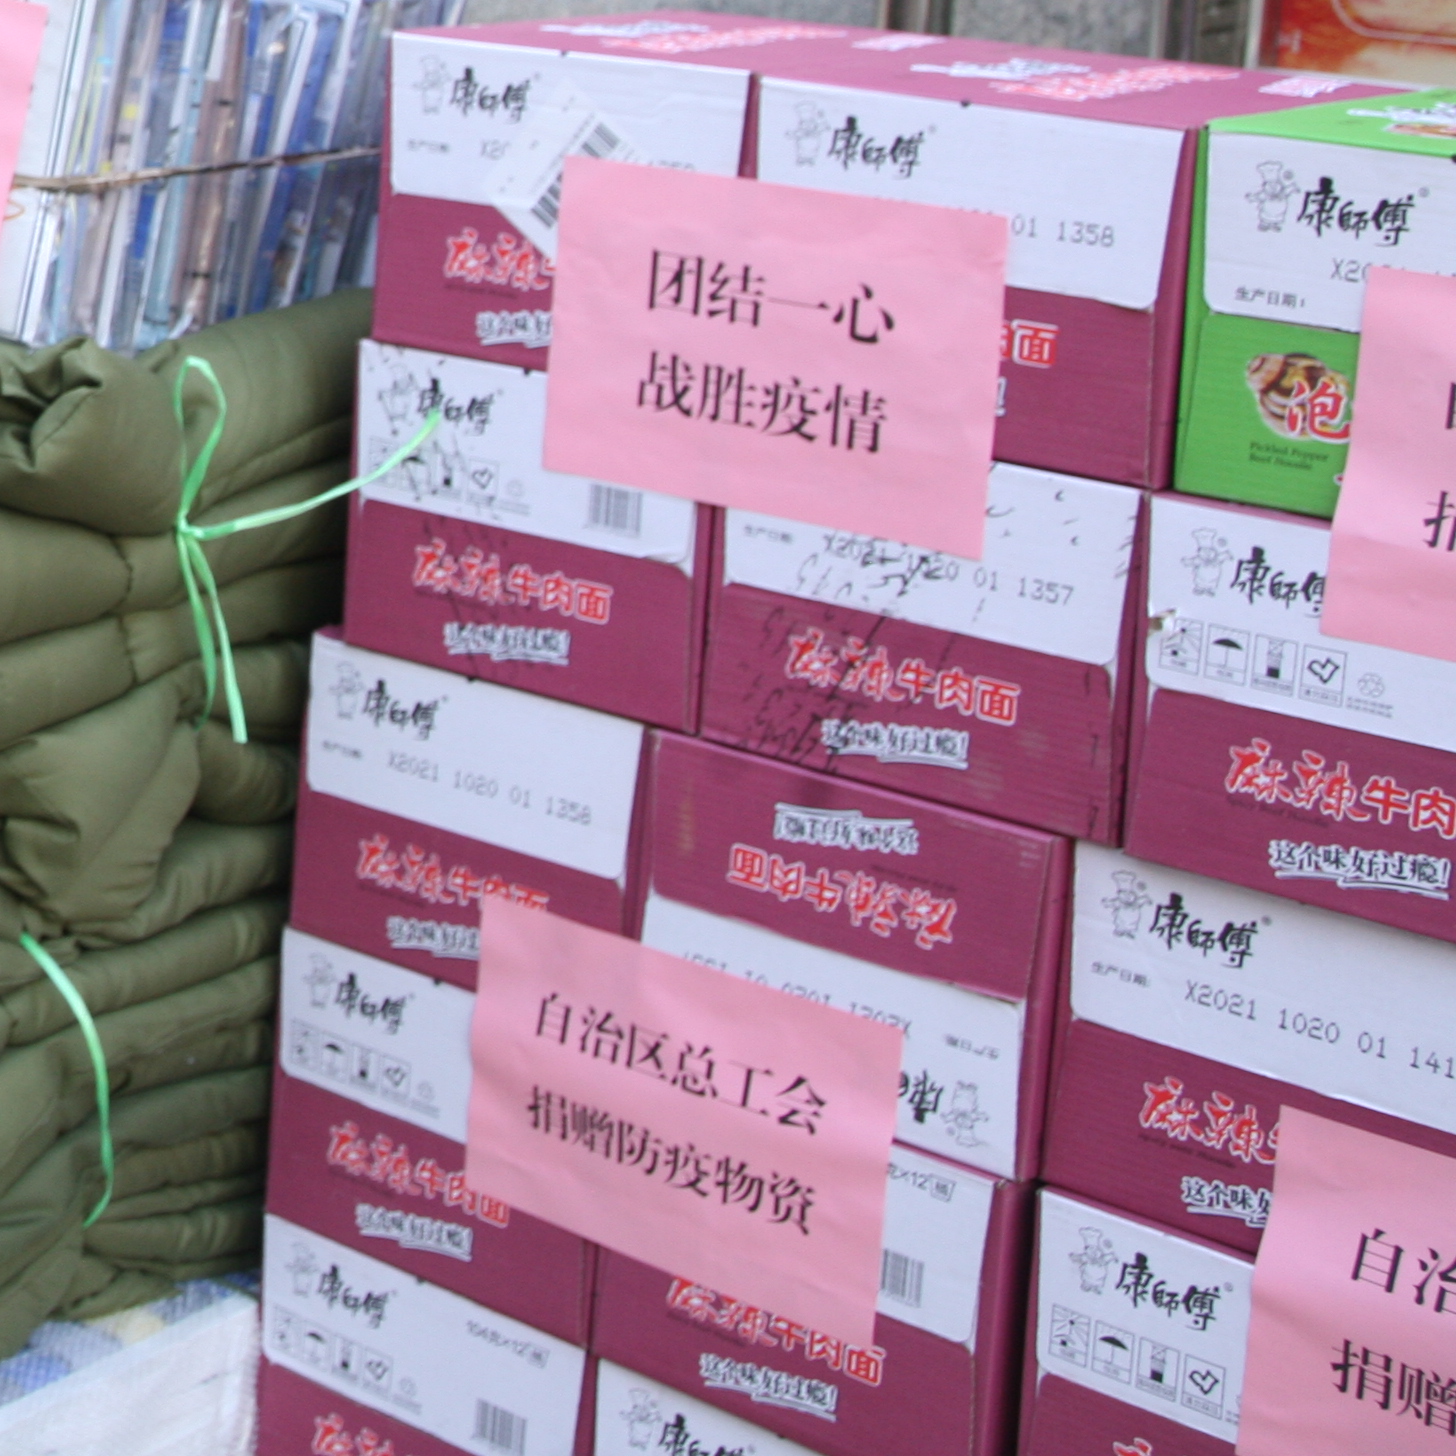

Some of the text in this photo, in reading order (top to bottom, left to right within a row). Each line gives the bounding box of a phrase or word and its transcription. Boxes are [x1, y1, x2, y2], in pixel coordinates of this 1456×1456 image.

[1011, 214, 1116, 248] 01 1358
[647, 249, 895, 345] 团结一心
[637, 350, 888, 454] 战胜疫情
[413, 538, 615, 626] 麻辣牛肉面
[973, 571, 999, 593] 01
[1018, 576, 1075, 607] 1357
[785, 626, 1021, 726] 麻辣牛肉面
[508, 785, 531, 809] 01
[1224, 737, 1456, 840] 麻辣牛肉
[535, 992, 828, 1136] 自治区总工会
[1183, 979, 1257, 1021] X2021
[1277, 1007, 1341, 1045] 1020
[1357, 1030, 1387, 1060] 01
[527, 1085, 817, 1236] 捐赠防疫物资
